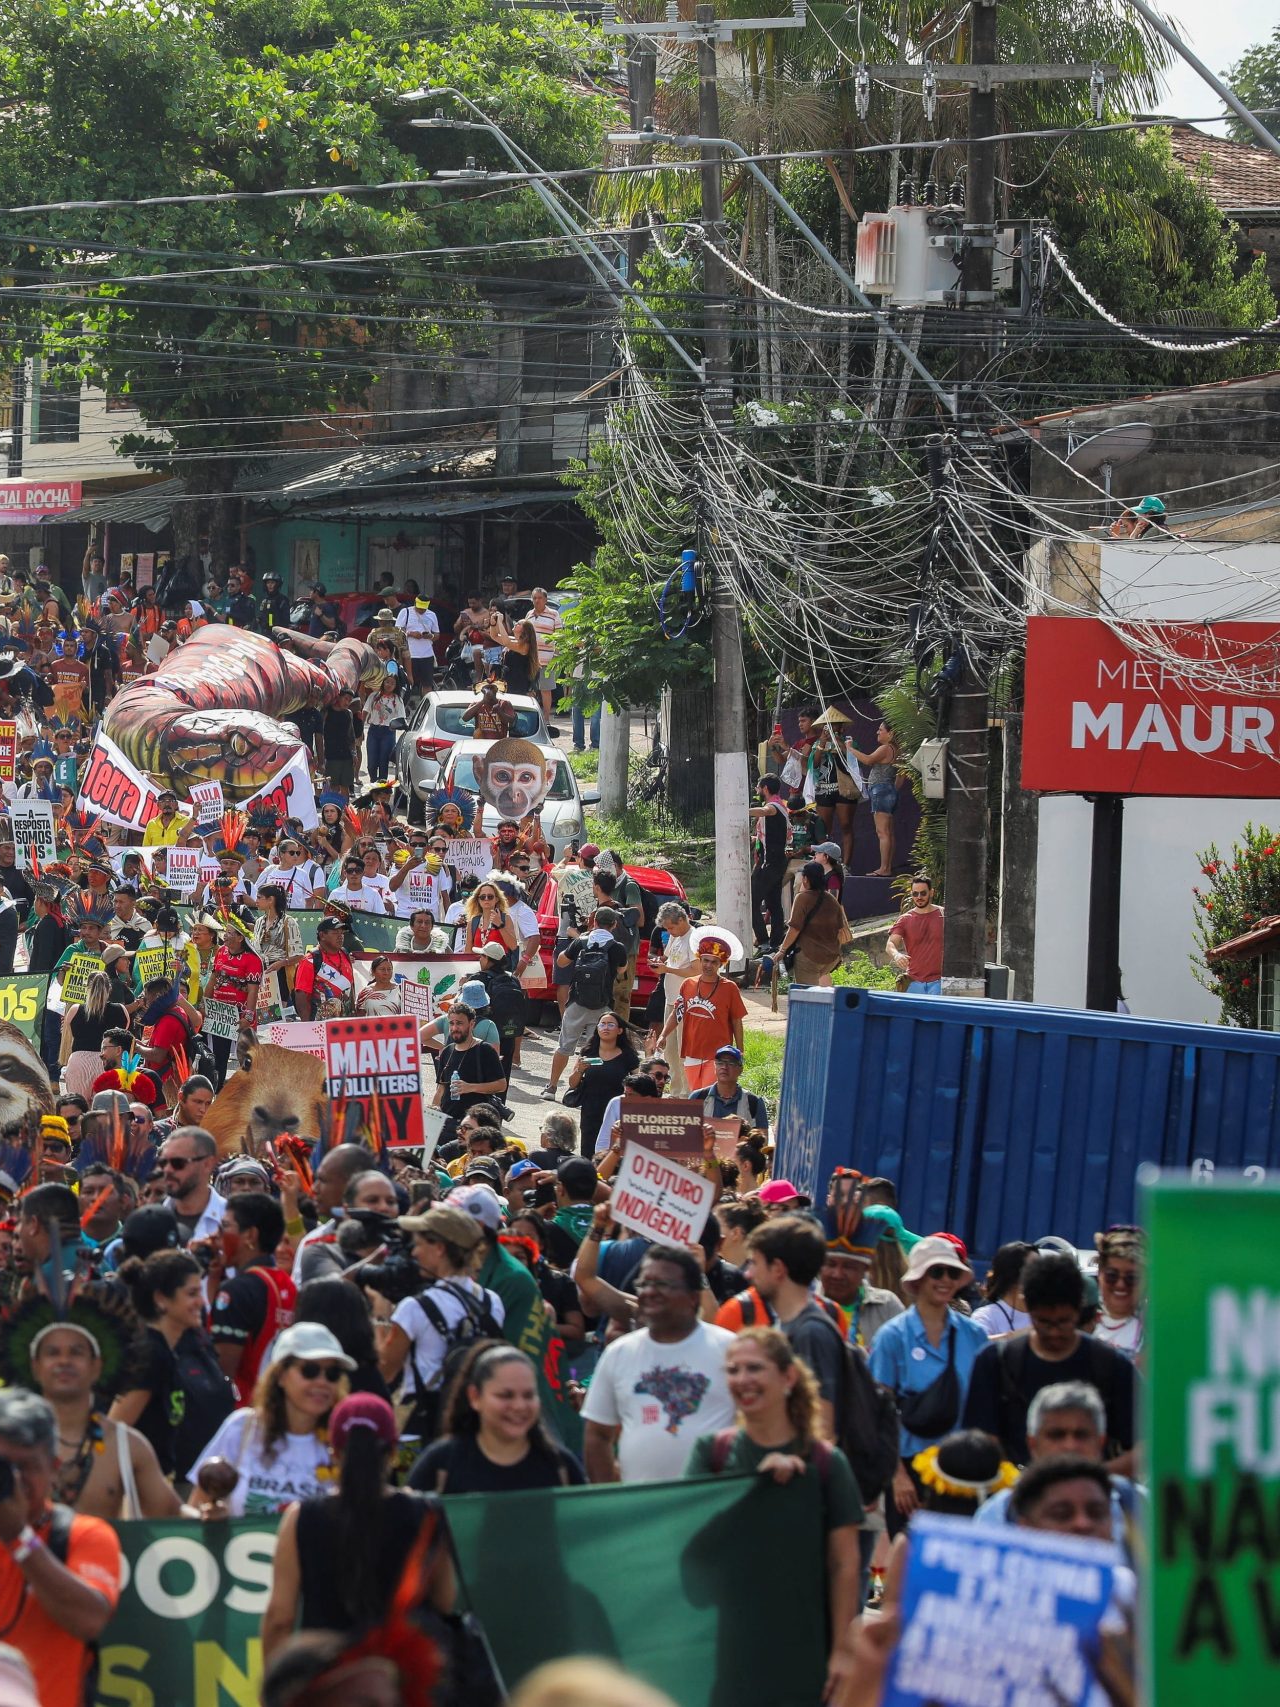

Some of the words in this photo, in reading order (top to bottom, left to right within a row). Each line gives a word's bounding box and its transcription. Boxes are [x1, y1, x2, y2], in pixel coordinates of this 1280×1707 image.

[26, 488, 70, 508] ROCHA
[195, 787, 221, 802] LULA
[28, 810, 34, 819] A
[14, 820, 51, 830] RESPOSTA
[16, 830, 52, 844] SOMOS
[170, 854, 197, 867] LULA
[457, 857, 485, 866] TAPAJÓS
[80, 959, 100, 970] TERRA
[143, 963, 162, 974] LIVRE
[205, 999, 236, 1018] SEMPRE
[205, 1010, 237, 1026] ESTIVEMOS
[210, 1021, 231, 1037] AQUI
[330, 1037, 416, 1076] MAKE
[623, 1114, 701, 1126] REFLORESTAR
[638, 1125, 686, 1135] MENTES
[633, 1155, 644, 1174] O
[645, 1161, 703, 1205] FUTURO
[656, 1188, 666, 1207] É
[615, 1190, 692, 1246] INDÍGENA
